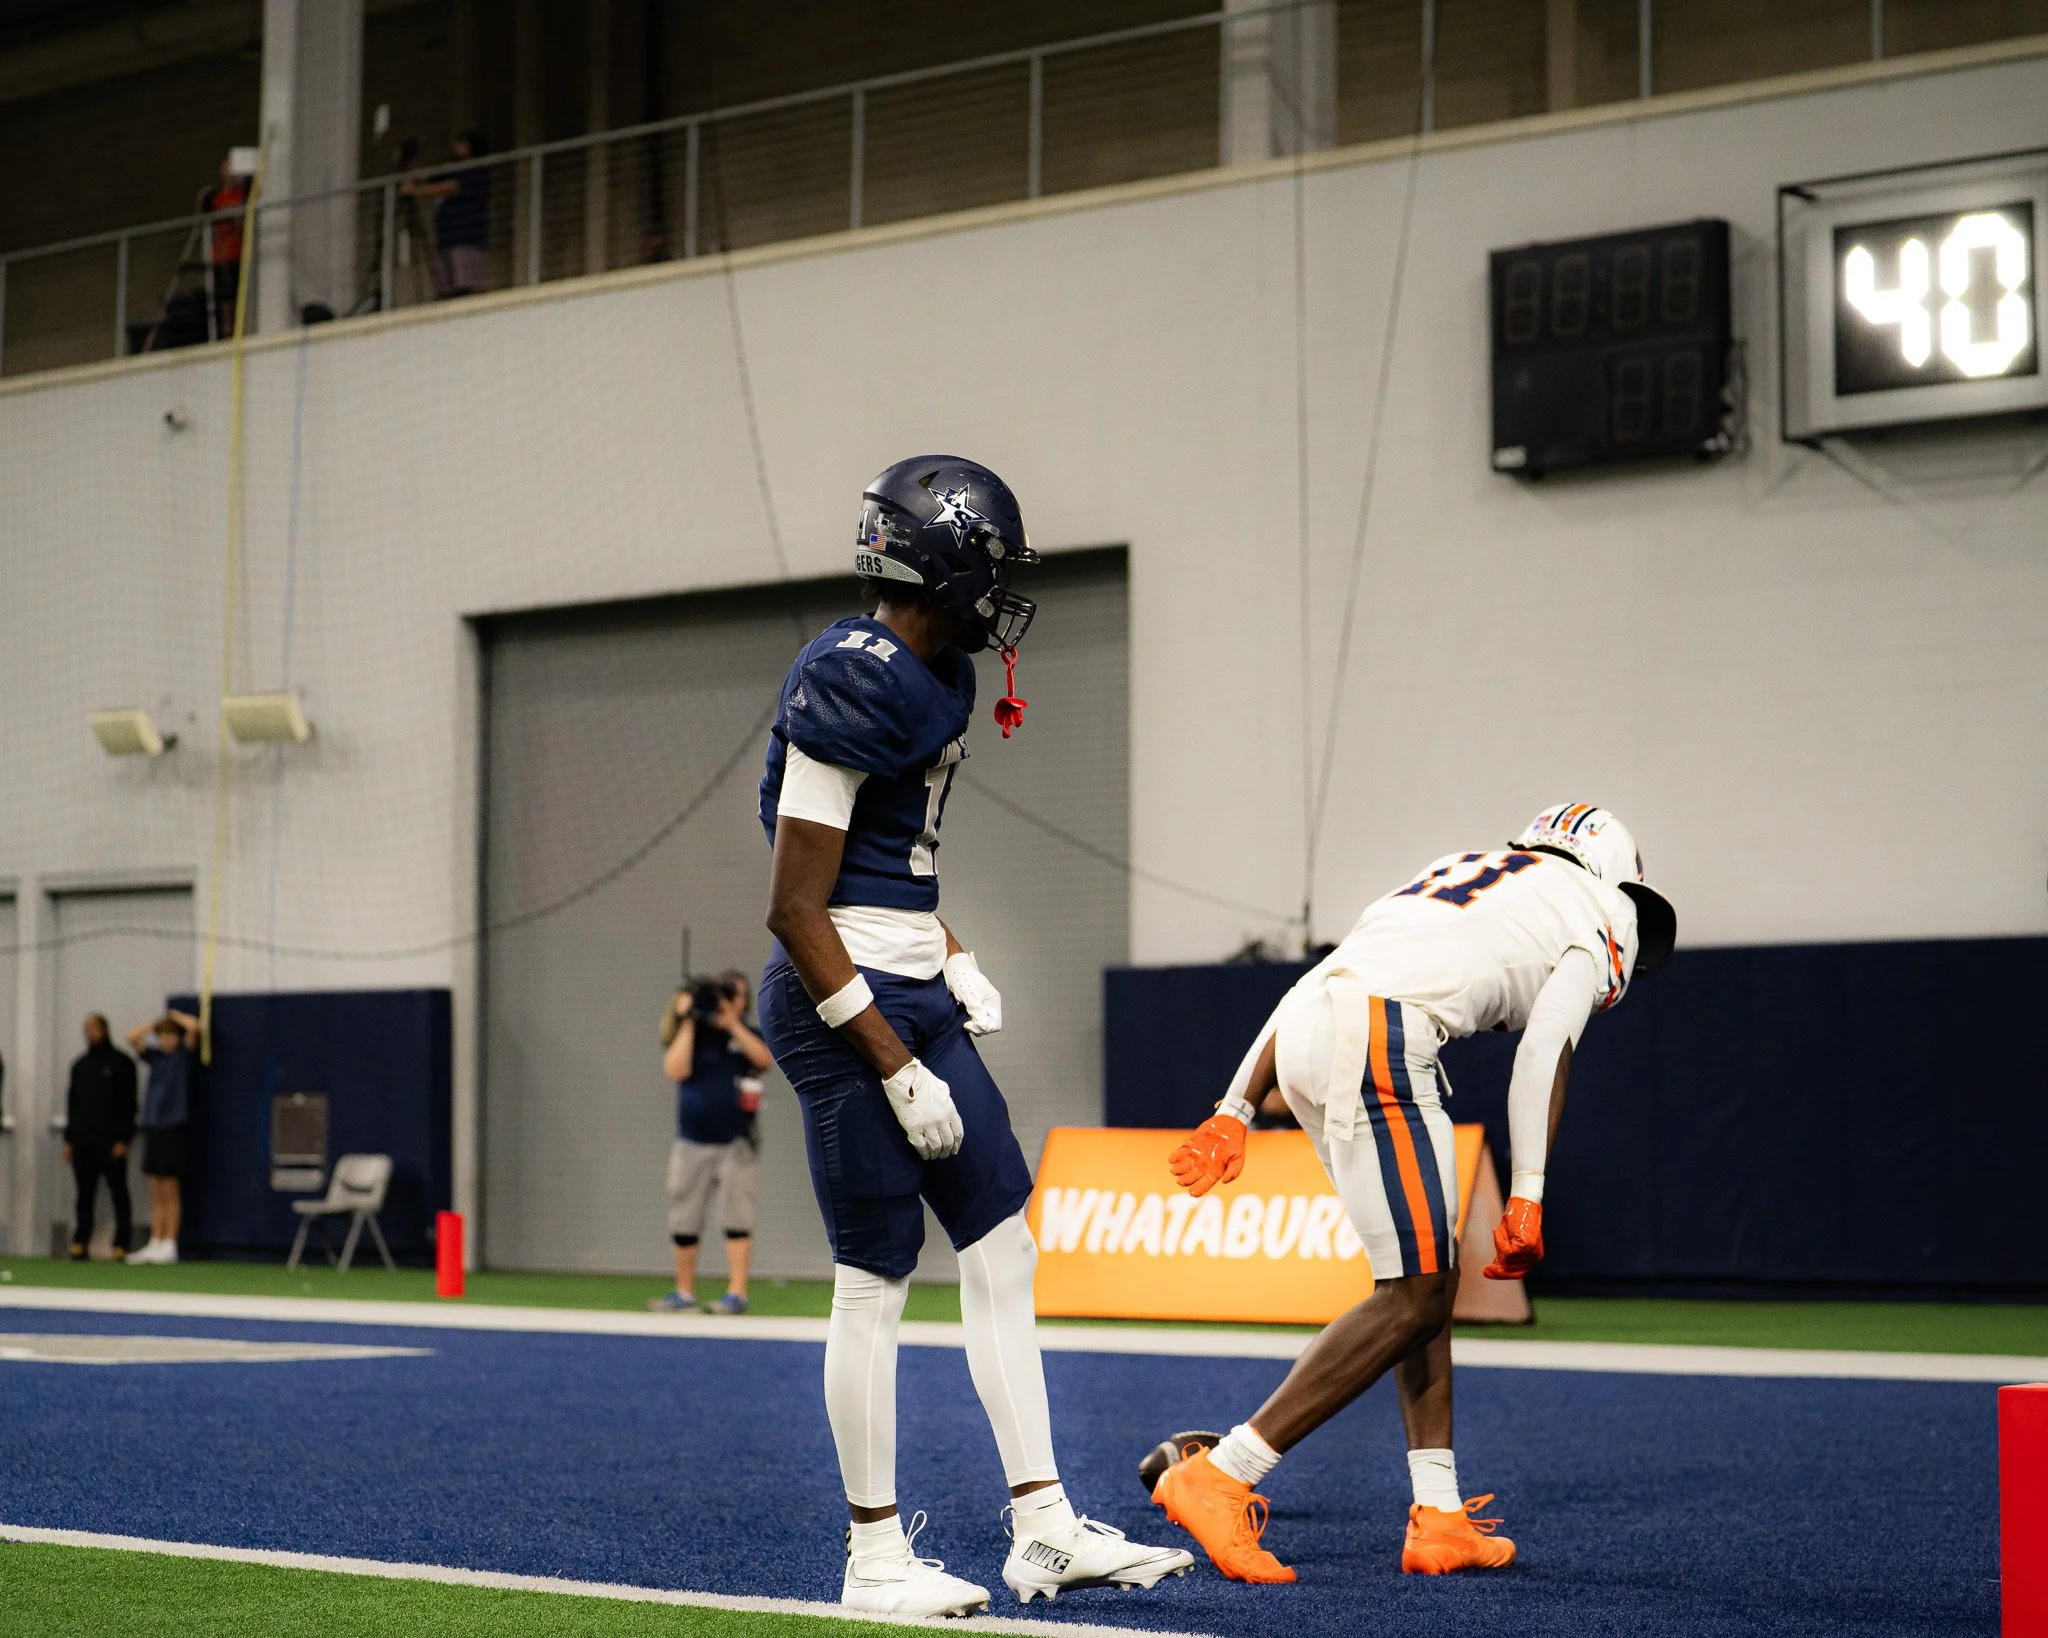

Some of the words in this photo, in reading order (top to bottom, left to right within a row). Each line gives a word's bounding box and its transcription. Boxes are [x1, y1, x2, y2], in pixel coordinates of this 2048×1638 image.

[1845, 212, 2028, 379] 40
[835, 630, 899, 663] 11
[1021, 1540, 1073, 1574] NIKE
